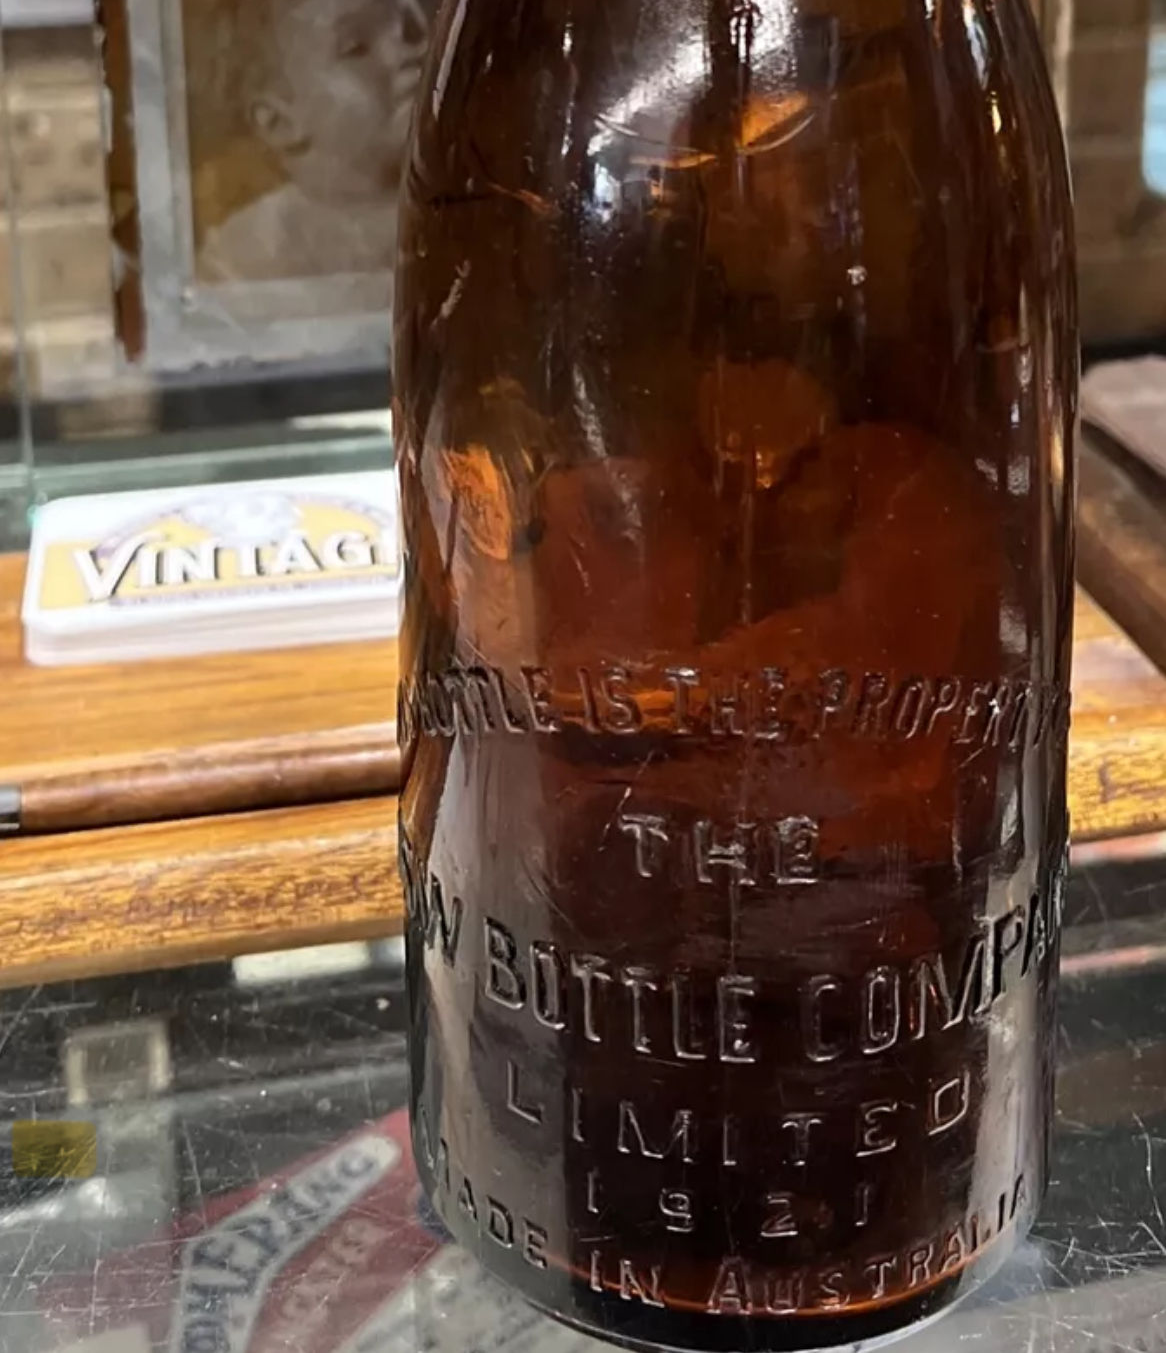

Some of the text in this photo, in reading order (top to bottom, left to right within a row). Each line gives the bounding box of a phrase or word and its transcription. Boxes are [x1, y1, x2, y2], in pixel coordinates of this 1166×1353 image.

[577, 666, 641, 734] IS
[663, 665, 786, 741] THE
[617, 812, 819, 887] THE
[483, 916, 756, 1062] BOTTLE
[506, 1058, 970, 1166] LIMITED
[420, 1108, 1028, 1314] MADE IN AUSTRALIA
